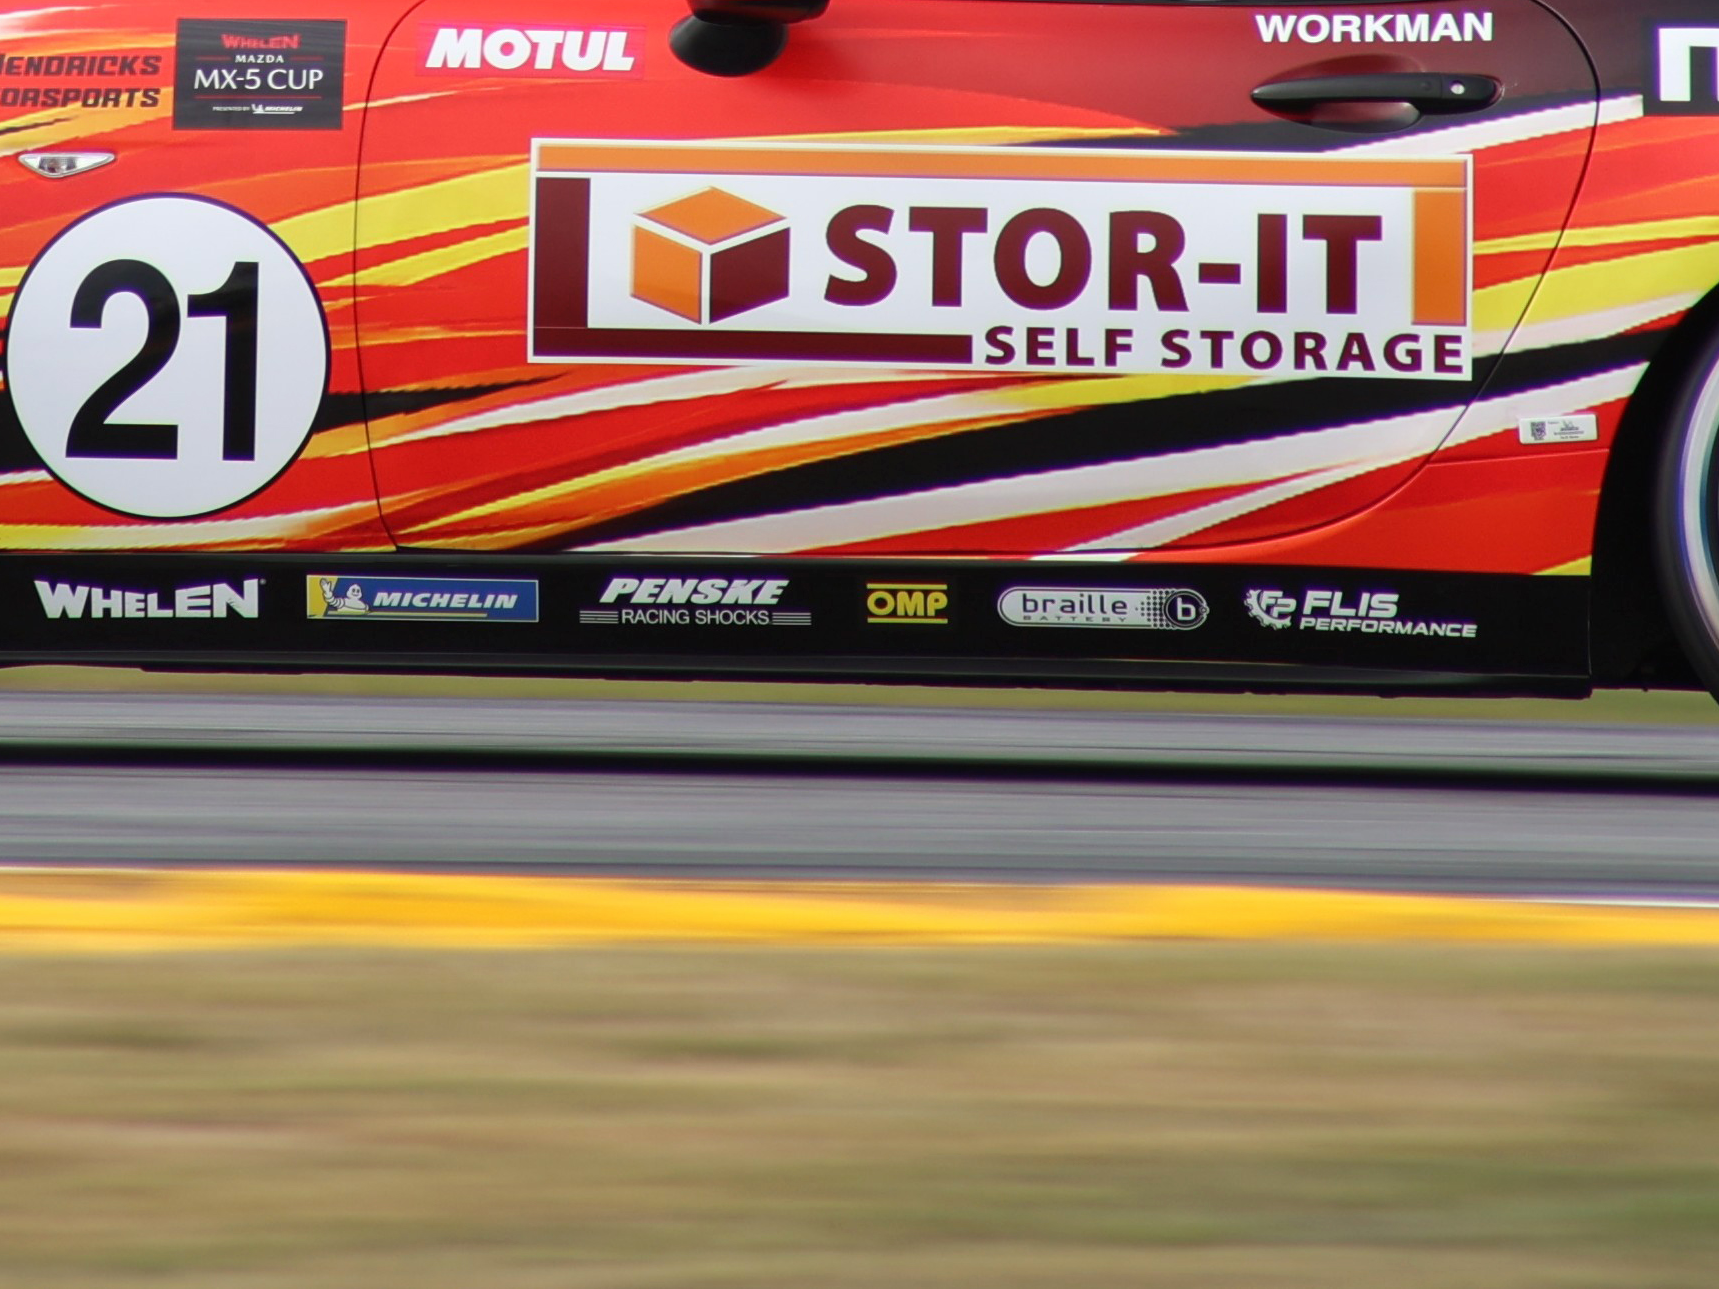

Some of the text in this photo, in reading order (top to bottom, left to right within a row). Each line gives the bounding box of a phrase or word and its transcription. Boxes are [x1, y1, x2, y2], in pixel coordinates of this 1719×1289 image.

[1254, 11, 1493, 44] WORKMAN
[220, 33, 301, 49] WHELEN
[424, 28, 635, 72] MOTUL
[234, 54, 285, 64] MAZDA
[193, 68, 324, 90] MX-5 CUP
[822, 203, 1383, 315] STOR-IT
[64, 257, 260, 463] 21
[984, 324, 1465, 374] SELF STORAGE
[33, 577, 260, 619] WHELEN
[372, 591, 519, 610] MICHELIN
[598, 577, 790, 605] PENSKE
[866, 591, 949, 617] OMP
[1022, 592, 1128, 615] braille
[621, 608, 771, 626] RACING SHOCKS
[1302, 590, 1400, 619] FLIS
[1022, 615, 1127, 623] BATTERY
[1299, 617, 1478, 638] PERFORMANCE
